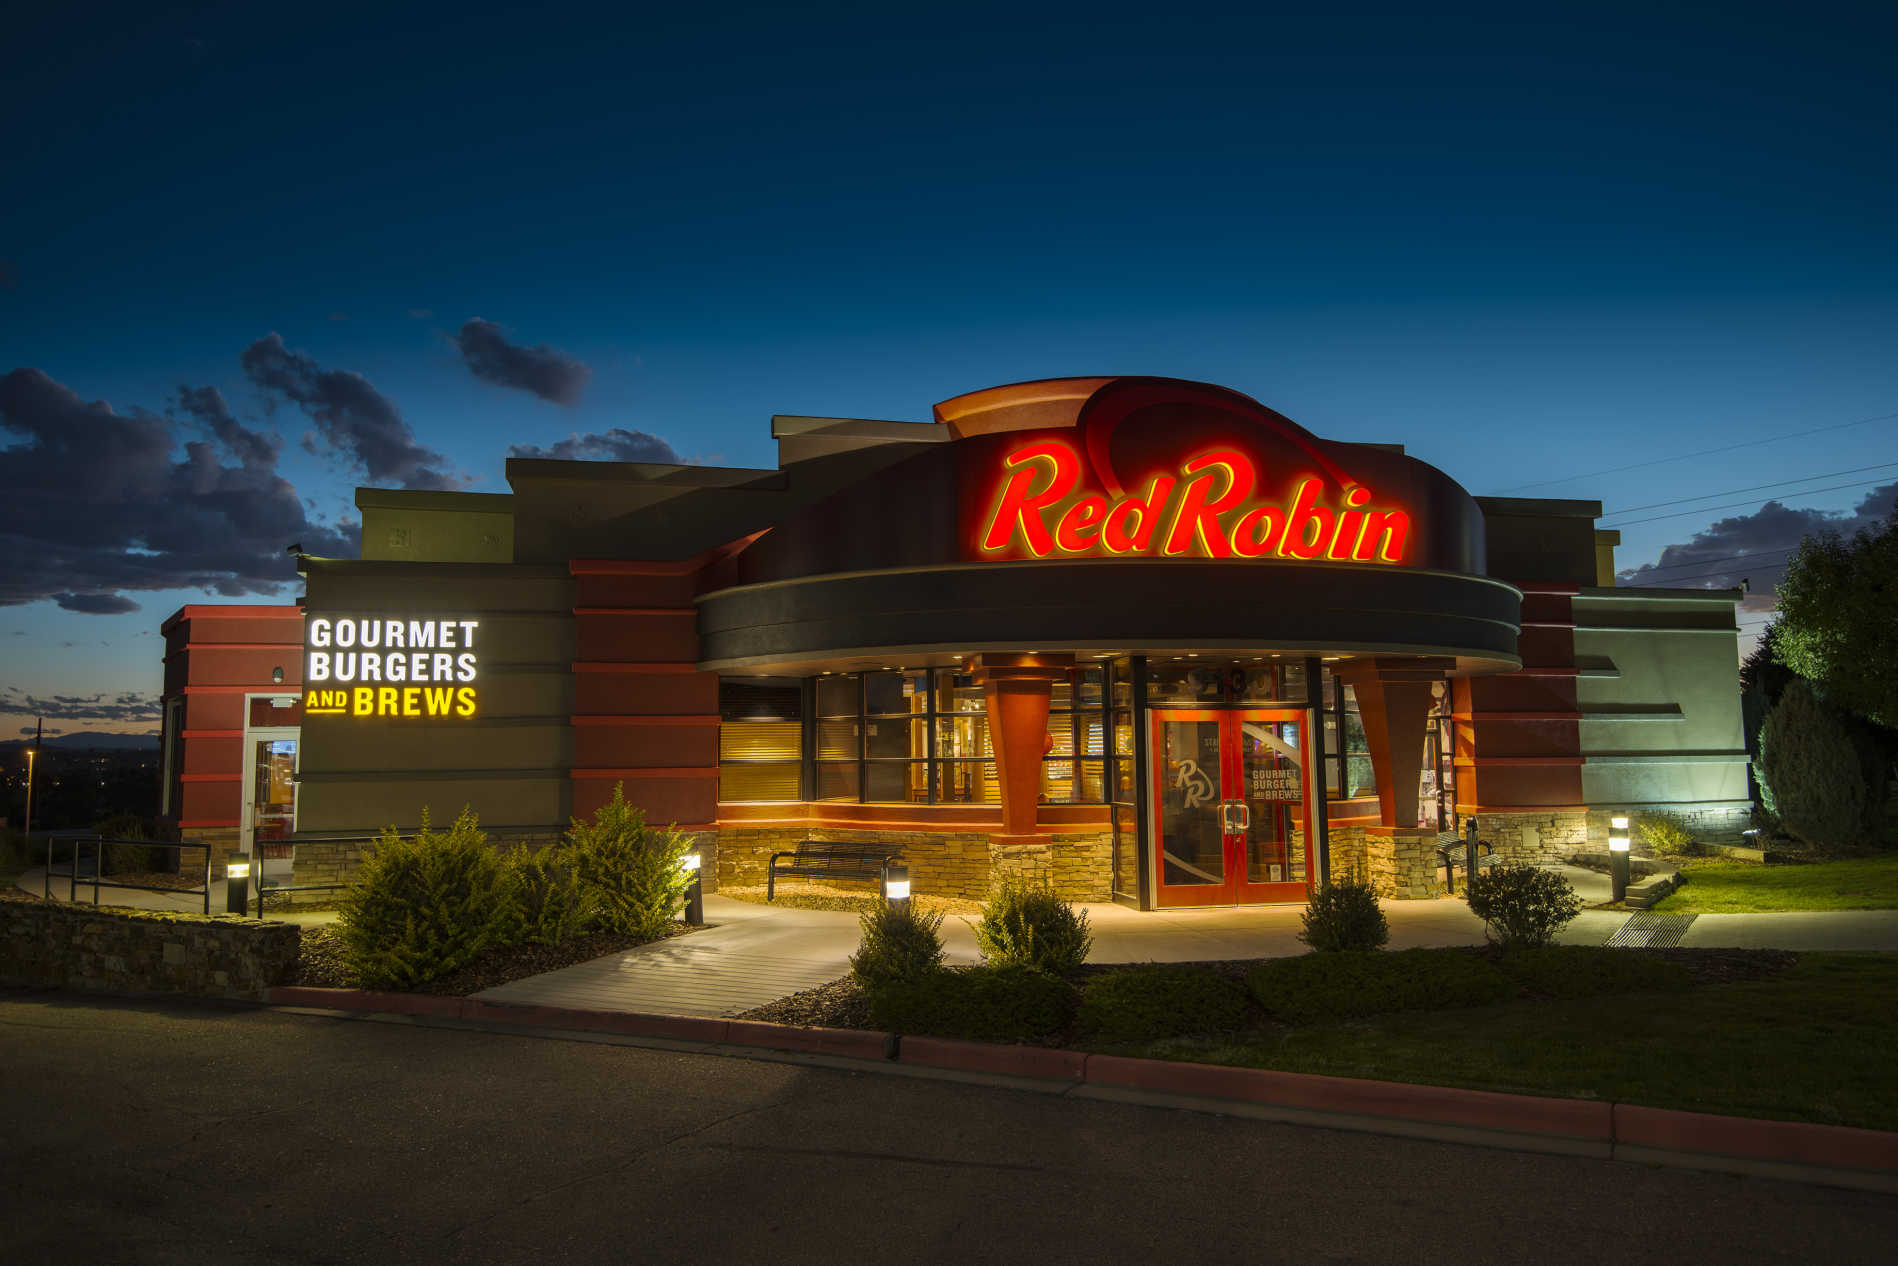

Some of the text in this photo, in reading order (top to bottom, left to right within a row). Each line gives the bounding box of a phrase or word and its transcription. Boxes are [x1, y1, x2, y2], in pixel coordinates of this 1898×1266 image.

[983, 441, 1410, 562] Red Robin
[310, 618, 480, 648] GOURMET
[309, 651, 477, 682] BURGERS
[306, 687, 477, 716] AND BREWS
[1252, 768, 1297, 780] GOURMET
[1265, 789, 1299, 800] BREWS
